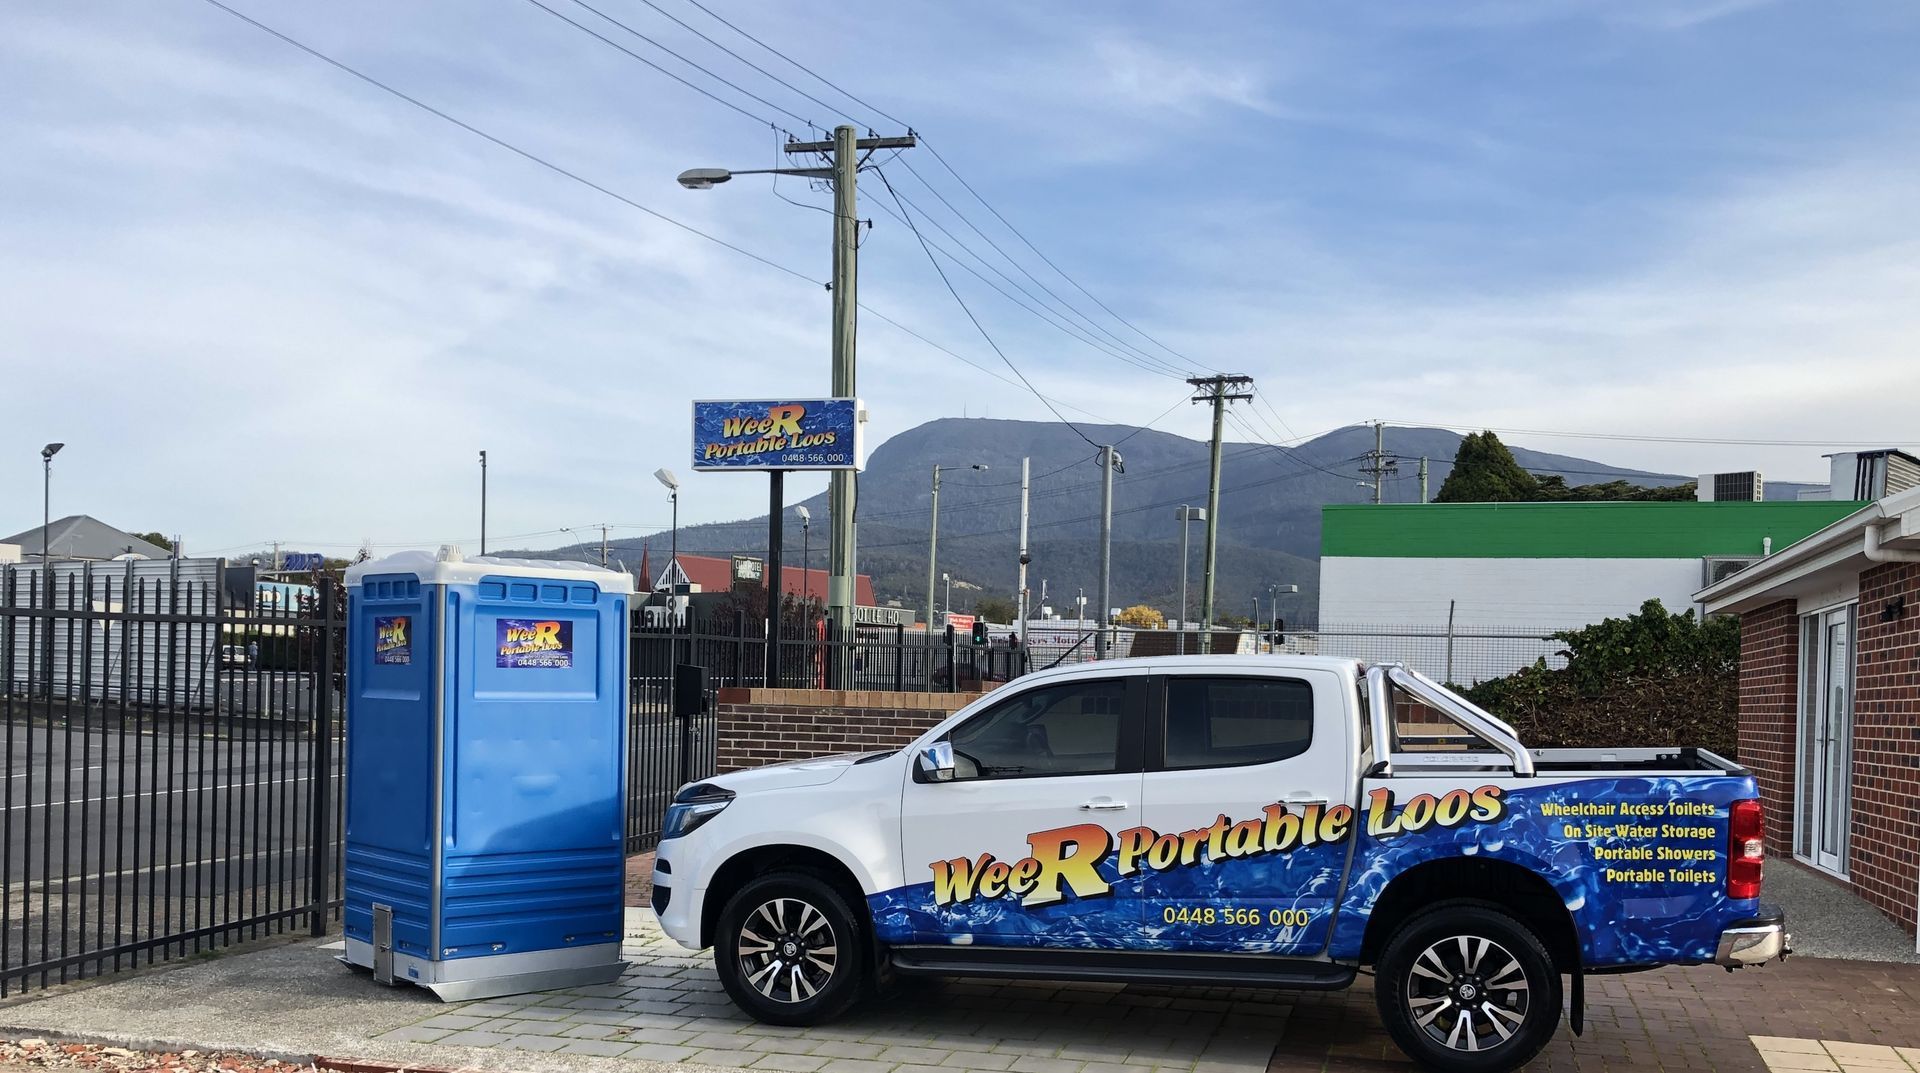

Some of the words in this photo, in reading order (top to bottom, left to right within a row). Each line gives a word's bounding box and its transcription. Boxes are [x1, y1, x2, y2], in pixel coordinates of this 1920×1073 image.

[705, 435, 787, 459] Portable
[790, 431, 836, 449] Loos
[782, 454, 804, 463] 0448
[807, 454, 824, 463] 566
[827, 453, 844, 463] 000
[1053, 634, 1088, 644] Motos
[500, 643, 541, 655] Portable
[541, 642, 563, 651] Loos
[539, 659, 553, 667] 566
[554, 659, 569, 667] 000
[1540, 802, 1616, 816] Wheelchair
[1620, 802, 1664, 816] Access
[1668, 803, 1715, 817] Toilets
[1117, 803, 1353, 876] Portable
[1366, 784, 1506, 839] Loos
[1563, 824, 1581, 838] On
[1585, 824, 1611, 838] Site
[1615, 824, 1657, 838] Water
[1661, 824, 1715, 839] Storage
[1595, 846, 1653, 860] Portable
[1657, 847, 1715, 861] Showers
[1606, 868, 1665, 882] Portable
[1669, 869, 1715, 883] Toilets
[1163, 906, 1216, 926] 0448
[1224, 907, 1261, 927] 566
[1268, 908, 1309, 928] 000
